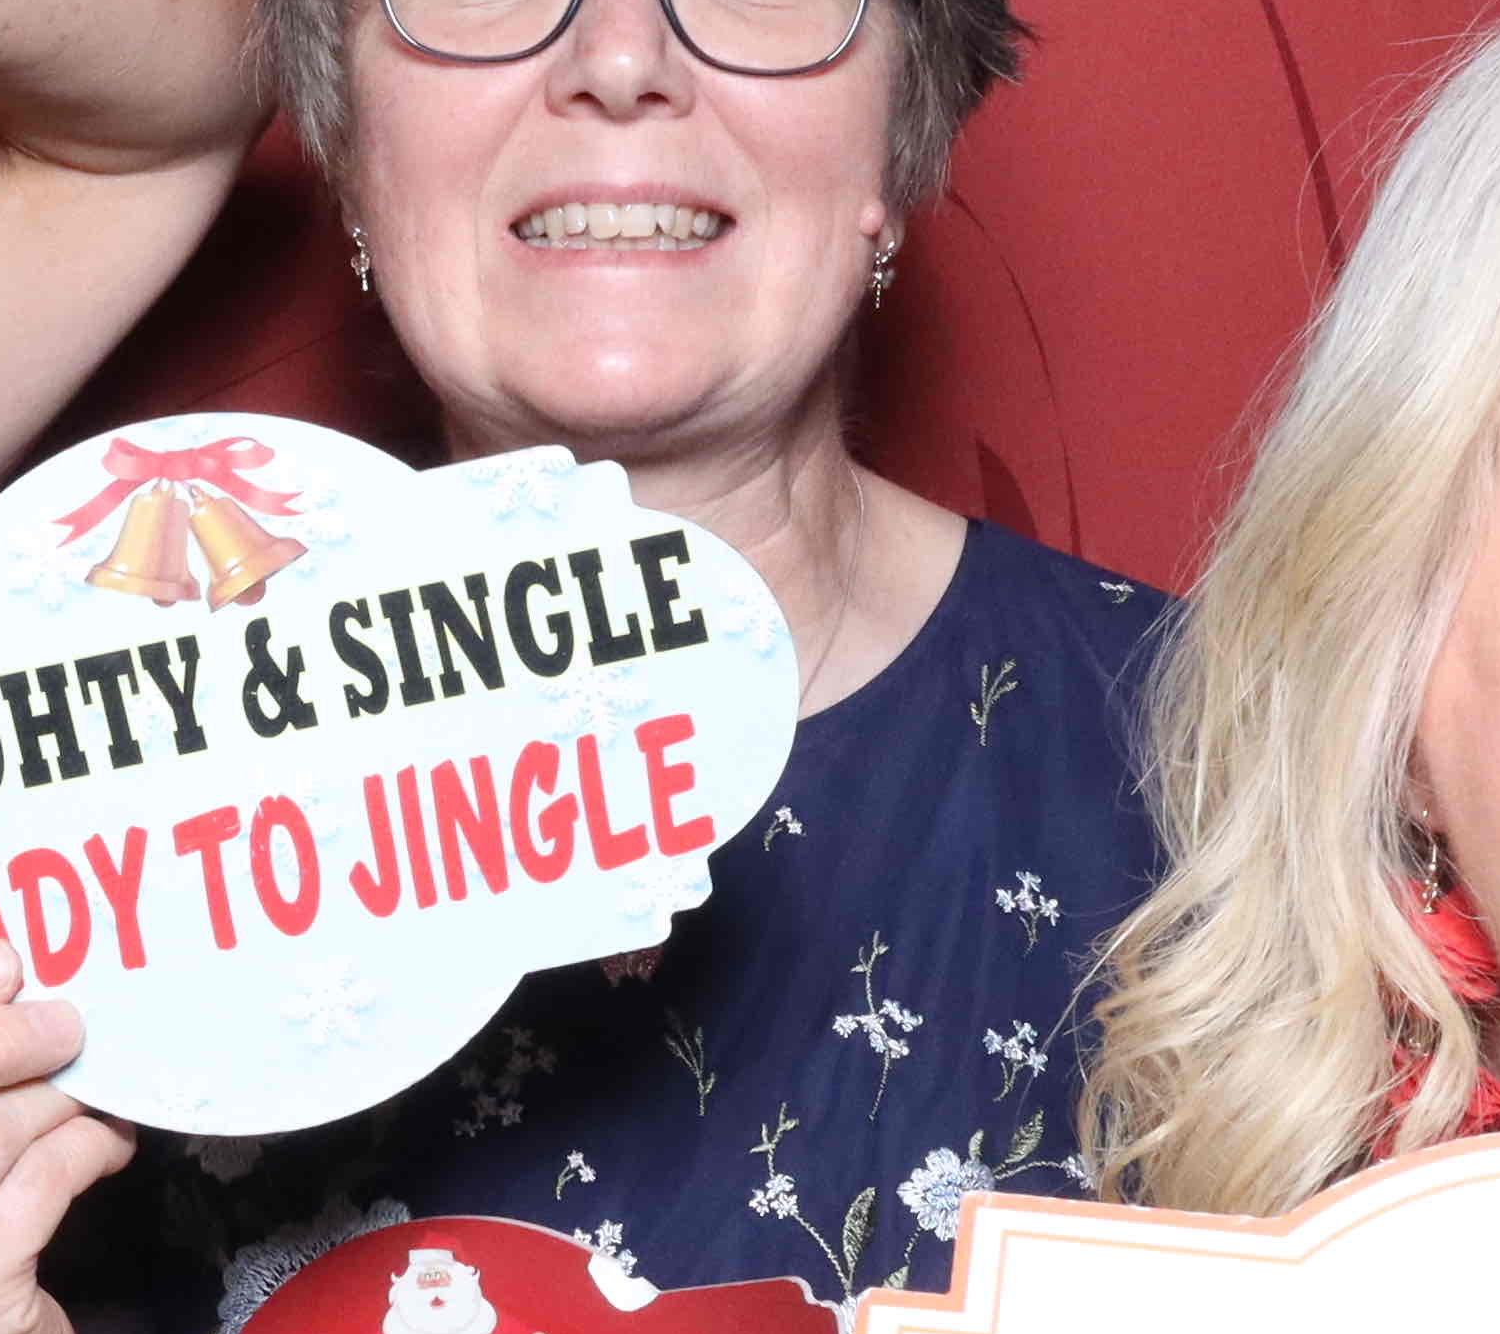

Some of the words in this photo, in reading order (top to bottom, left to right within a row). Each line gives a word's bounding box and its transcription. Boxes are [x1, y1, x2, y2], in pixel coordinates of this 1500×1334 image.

[241, 616, 318, 740] &
[329, 529, 710, 723] SINGLE
[174, 794, 322, 952] TO
[348, 712, 715, 919] JINGLE
